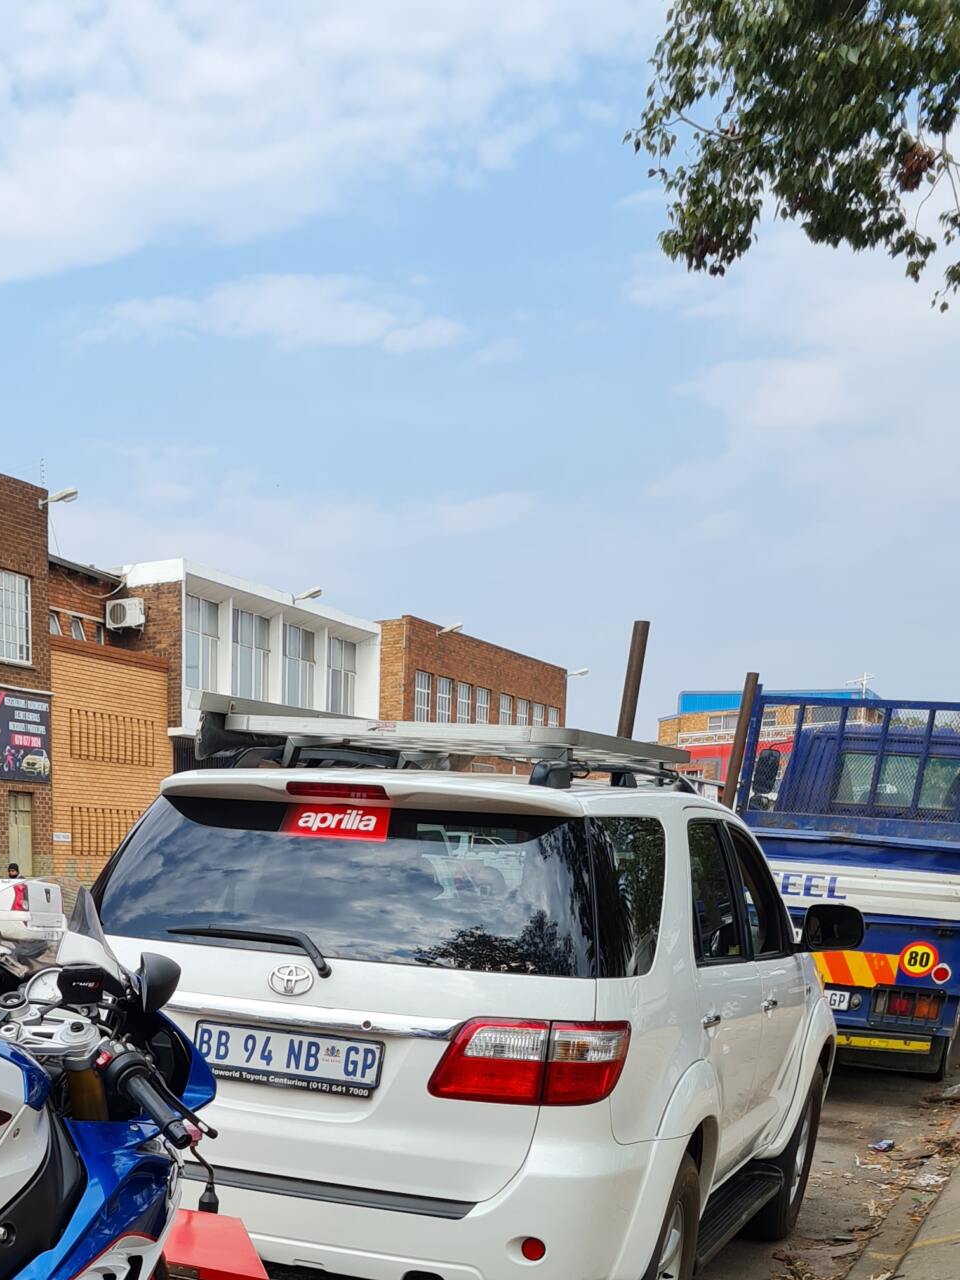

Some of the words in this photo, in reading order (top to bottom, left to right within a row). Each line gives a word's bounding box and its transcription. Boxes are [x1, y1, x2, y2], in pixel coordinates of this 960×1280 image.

[298, 809, 377, 831] aprilia
[772, 873, 846, 899] EEL
[907, 951, 930, 967] 80
[829, 993, 845, 1007] GP
[198, 1028, 230, 1060] BB
[243, 1034, 273, 1066] 94
[286, 1039, 320, 1072] NB
[343, 1046, 376, 1078] GP
[242, 1072, 267, 1081] Toyota
[269, 1075, 307, 1087] Centurion
[309, 1082, 330, 1091] (012)
[349, 1087, 369, 1096] 7000
